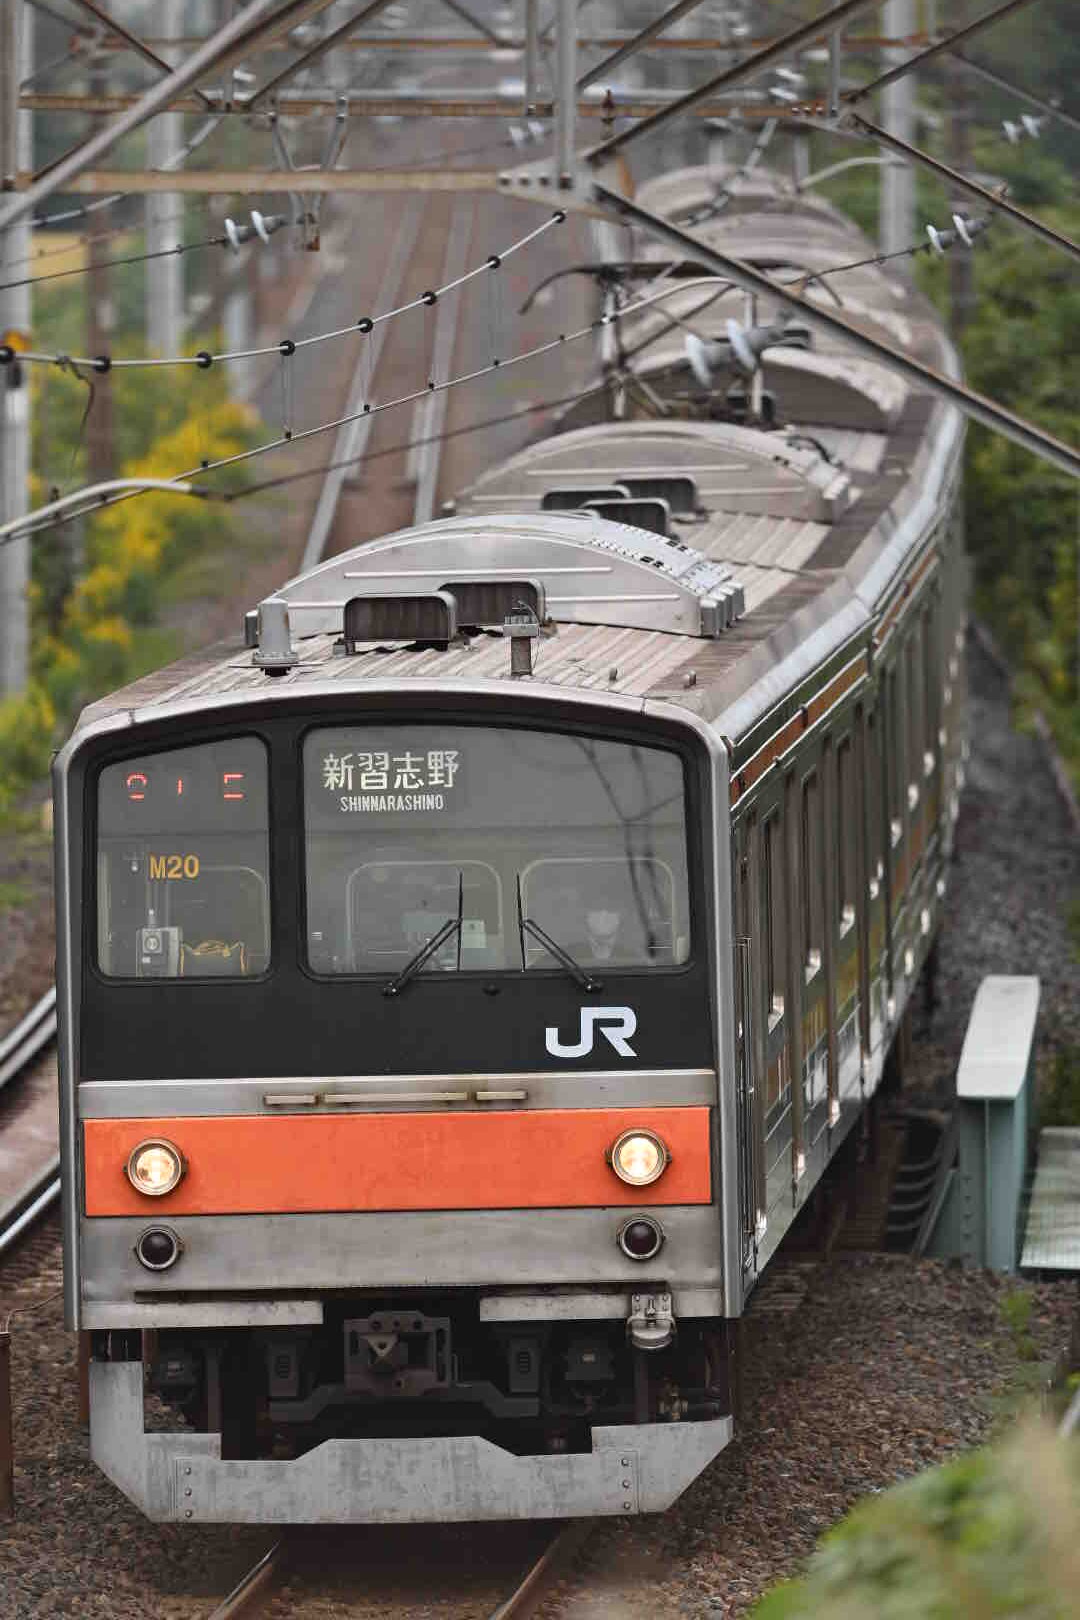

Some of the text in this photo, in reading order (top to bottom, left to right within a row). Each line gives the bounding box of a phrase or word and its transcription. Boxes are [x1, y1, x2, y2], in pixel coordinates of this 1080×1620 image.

[323, 751, 459, 790] 新習志野
[340, 794, 444, 812] SHINNARASHINO
[149, 854, 200, 879] M20
[545, 1006, 638, 1058] JR
